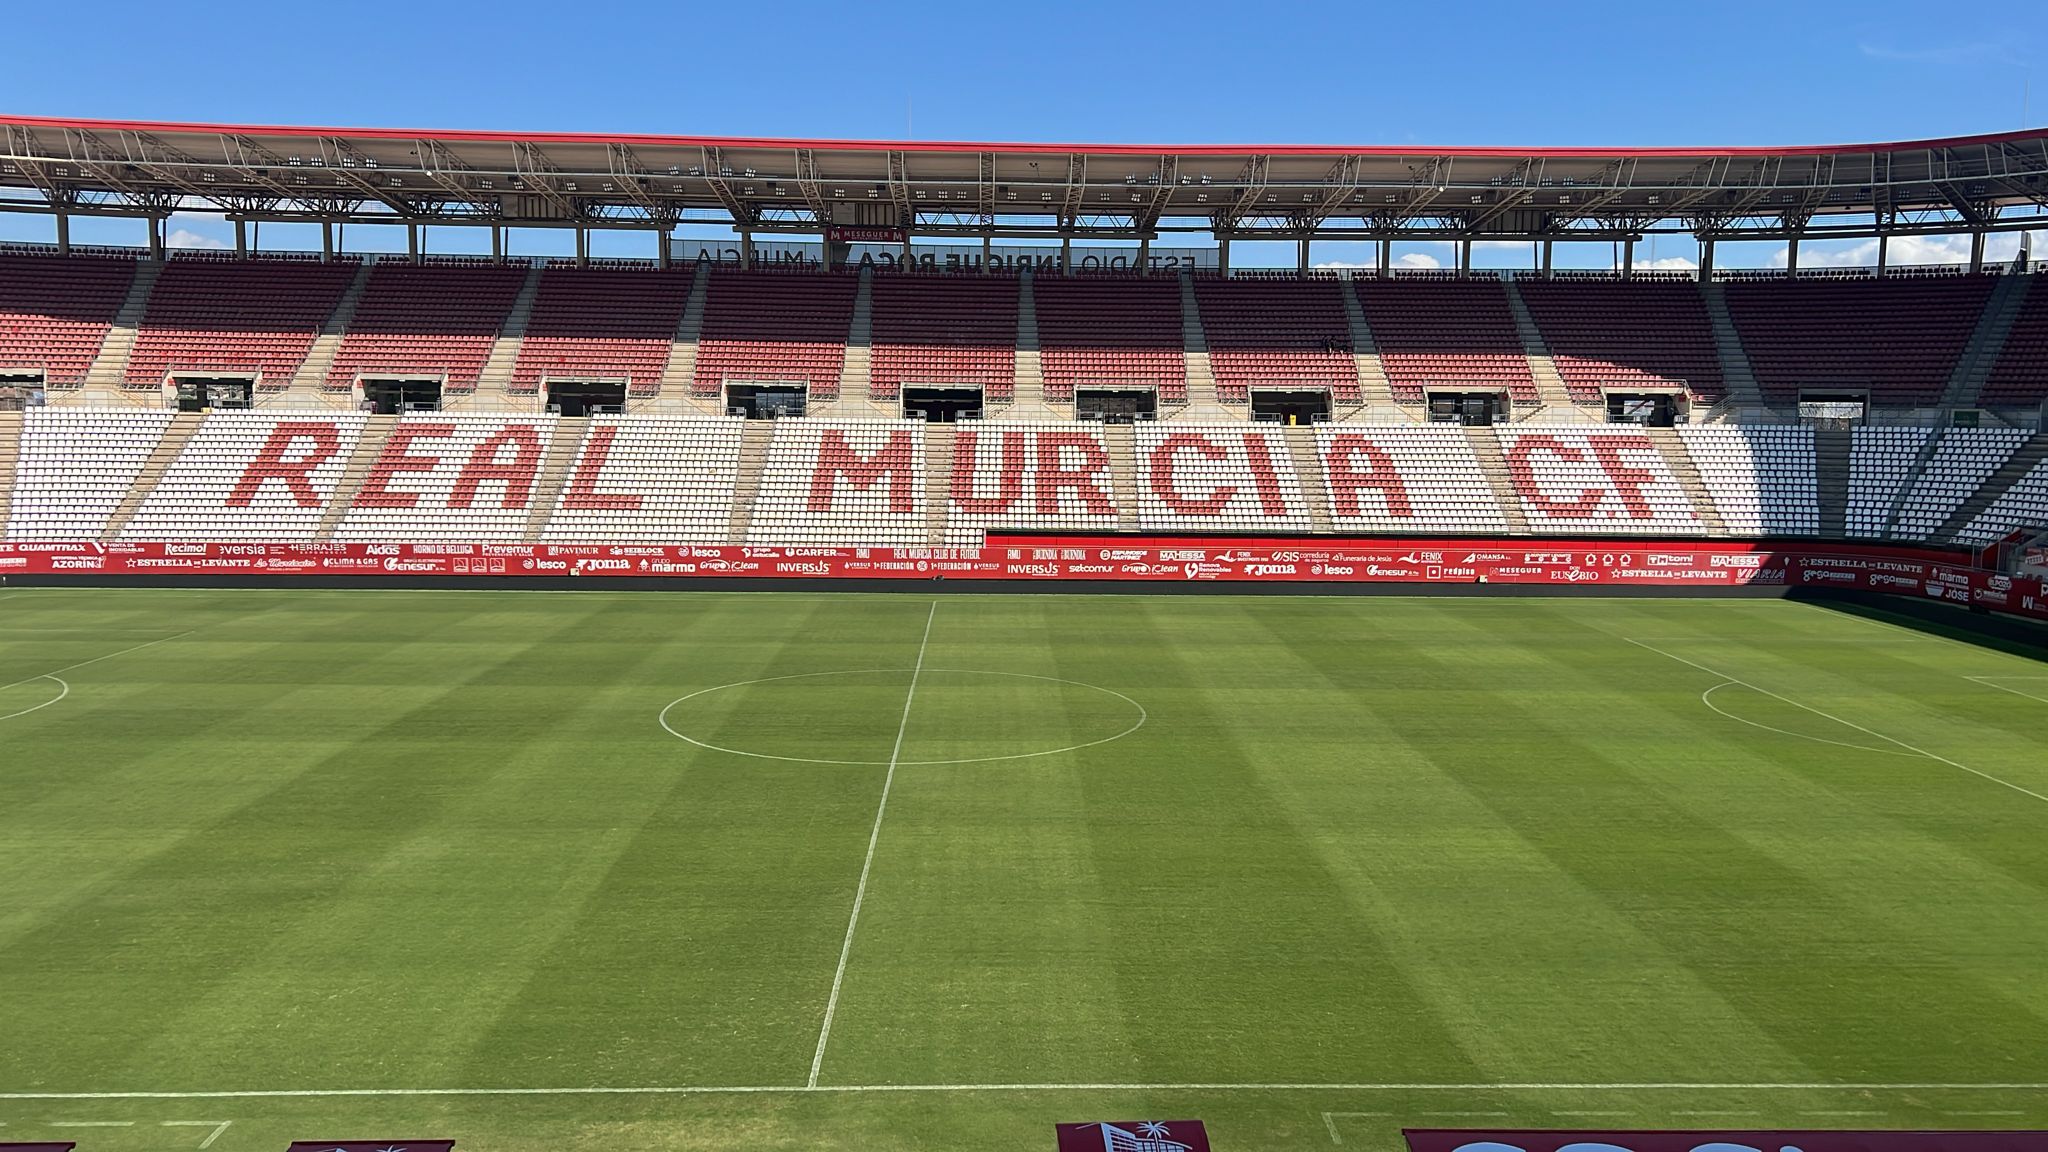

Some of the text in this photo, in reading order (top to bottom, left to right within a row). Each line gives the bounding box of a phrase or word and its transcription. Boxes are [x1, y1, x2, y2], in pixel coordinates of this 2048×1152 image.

[224, 422, 1654, 518] REAL MURCIA CF
[165, 543, 207, 555] Recimol
[289, 543, 347, 551] HERRAJES
[413, 544, 436, 554] HORNO
[436, 544, 446, 554] DE
[482, 544, 535, 555] Prevemur
[559, 546, 599, 555] PAVIMUR
[691, 546, 721, 557] lesco
[796, 548, 837, 557] CARFER
[908, 548, 932, 560] MURCIA
[933, 548, 949, 560] CLUB
[949, 548, 958, 560] DE
[1160, 551, 1206, 561] MAHESSA
[1421, 552, 1443, 560] FENIX
[137, 559, 193, 567] ESTRELLA
[201, 559, 250, 567] LEVANTE
[536, 558, 567, 569] lesco
[1711, 556, 1760, 567] MAHESSA
[1811, 558, 1867, 569] ESTRELLA
[1876, 562, 1923, 574] LEVANTE
[652, 563, 696, 573] marmo
[1069, 563, 1114, 573] setcomur
[1324, 564, 1353, 575] lesco
[1622, 569, 1673, 577] ESTRELLA
[1681, 570, 1728, 579] LEVANTE
[1939, 573, 1969, 585] marmo
